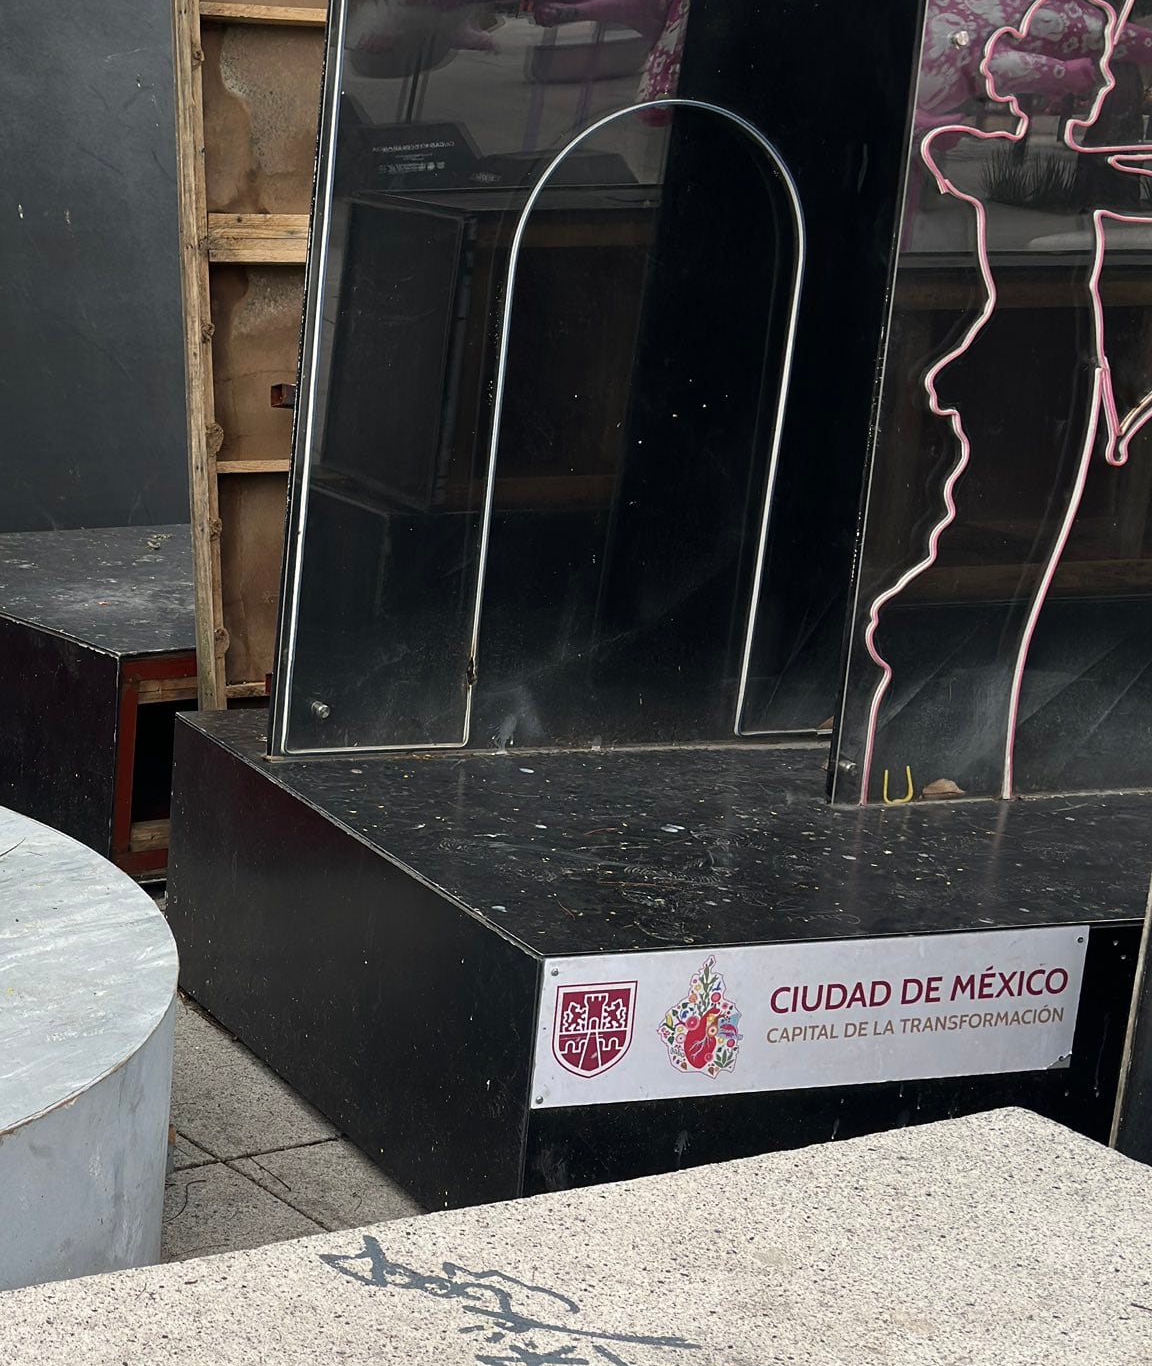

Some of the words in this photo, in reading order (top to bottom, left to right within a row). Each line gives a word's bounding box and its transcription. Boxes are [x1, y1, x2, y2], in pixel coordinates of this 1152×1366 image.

[769, 980, 892, 1014] CIUDAD
[900, 976, 943, 1005] DE
[950, 965, 1069, 1002] MÉXICO
[766, 1024, 839, 1044] CAPITAL
[844, 1021, 868, 1038] DE
[873, 1019, 895, 1036] LA
[900, 1004, 1065, 1034] TRANSFORMACIÓN
